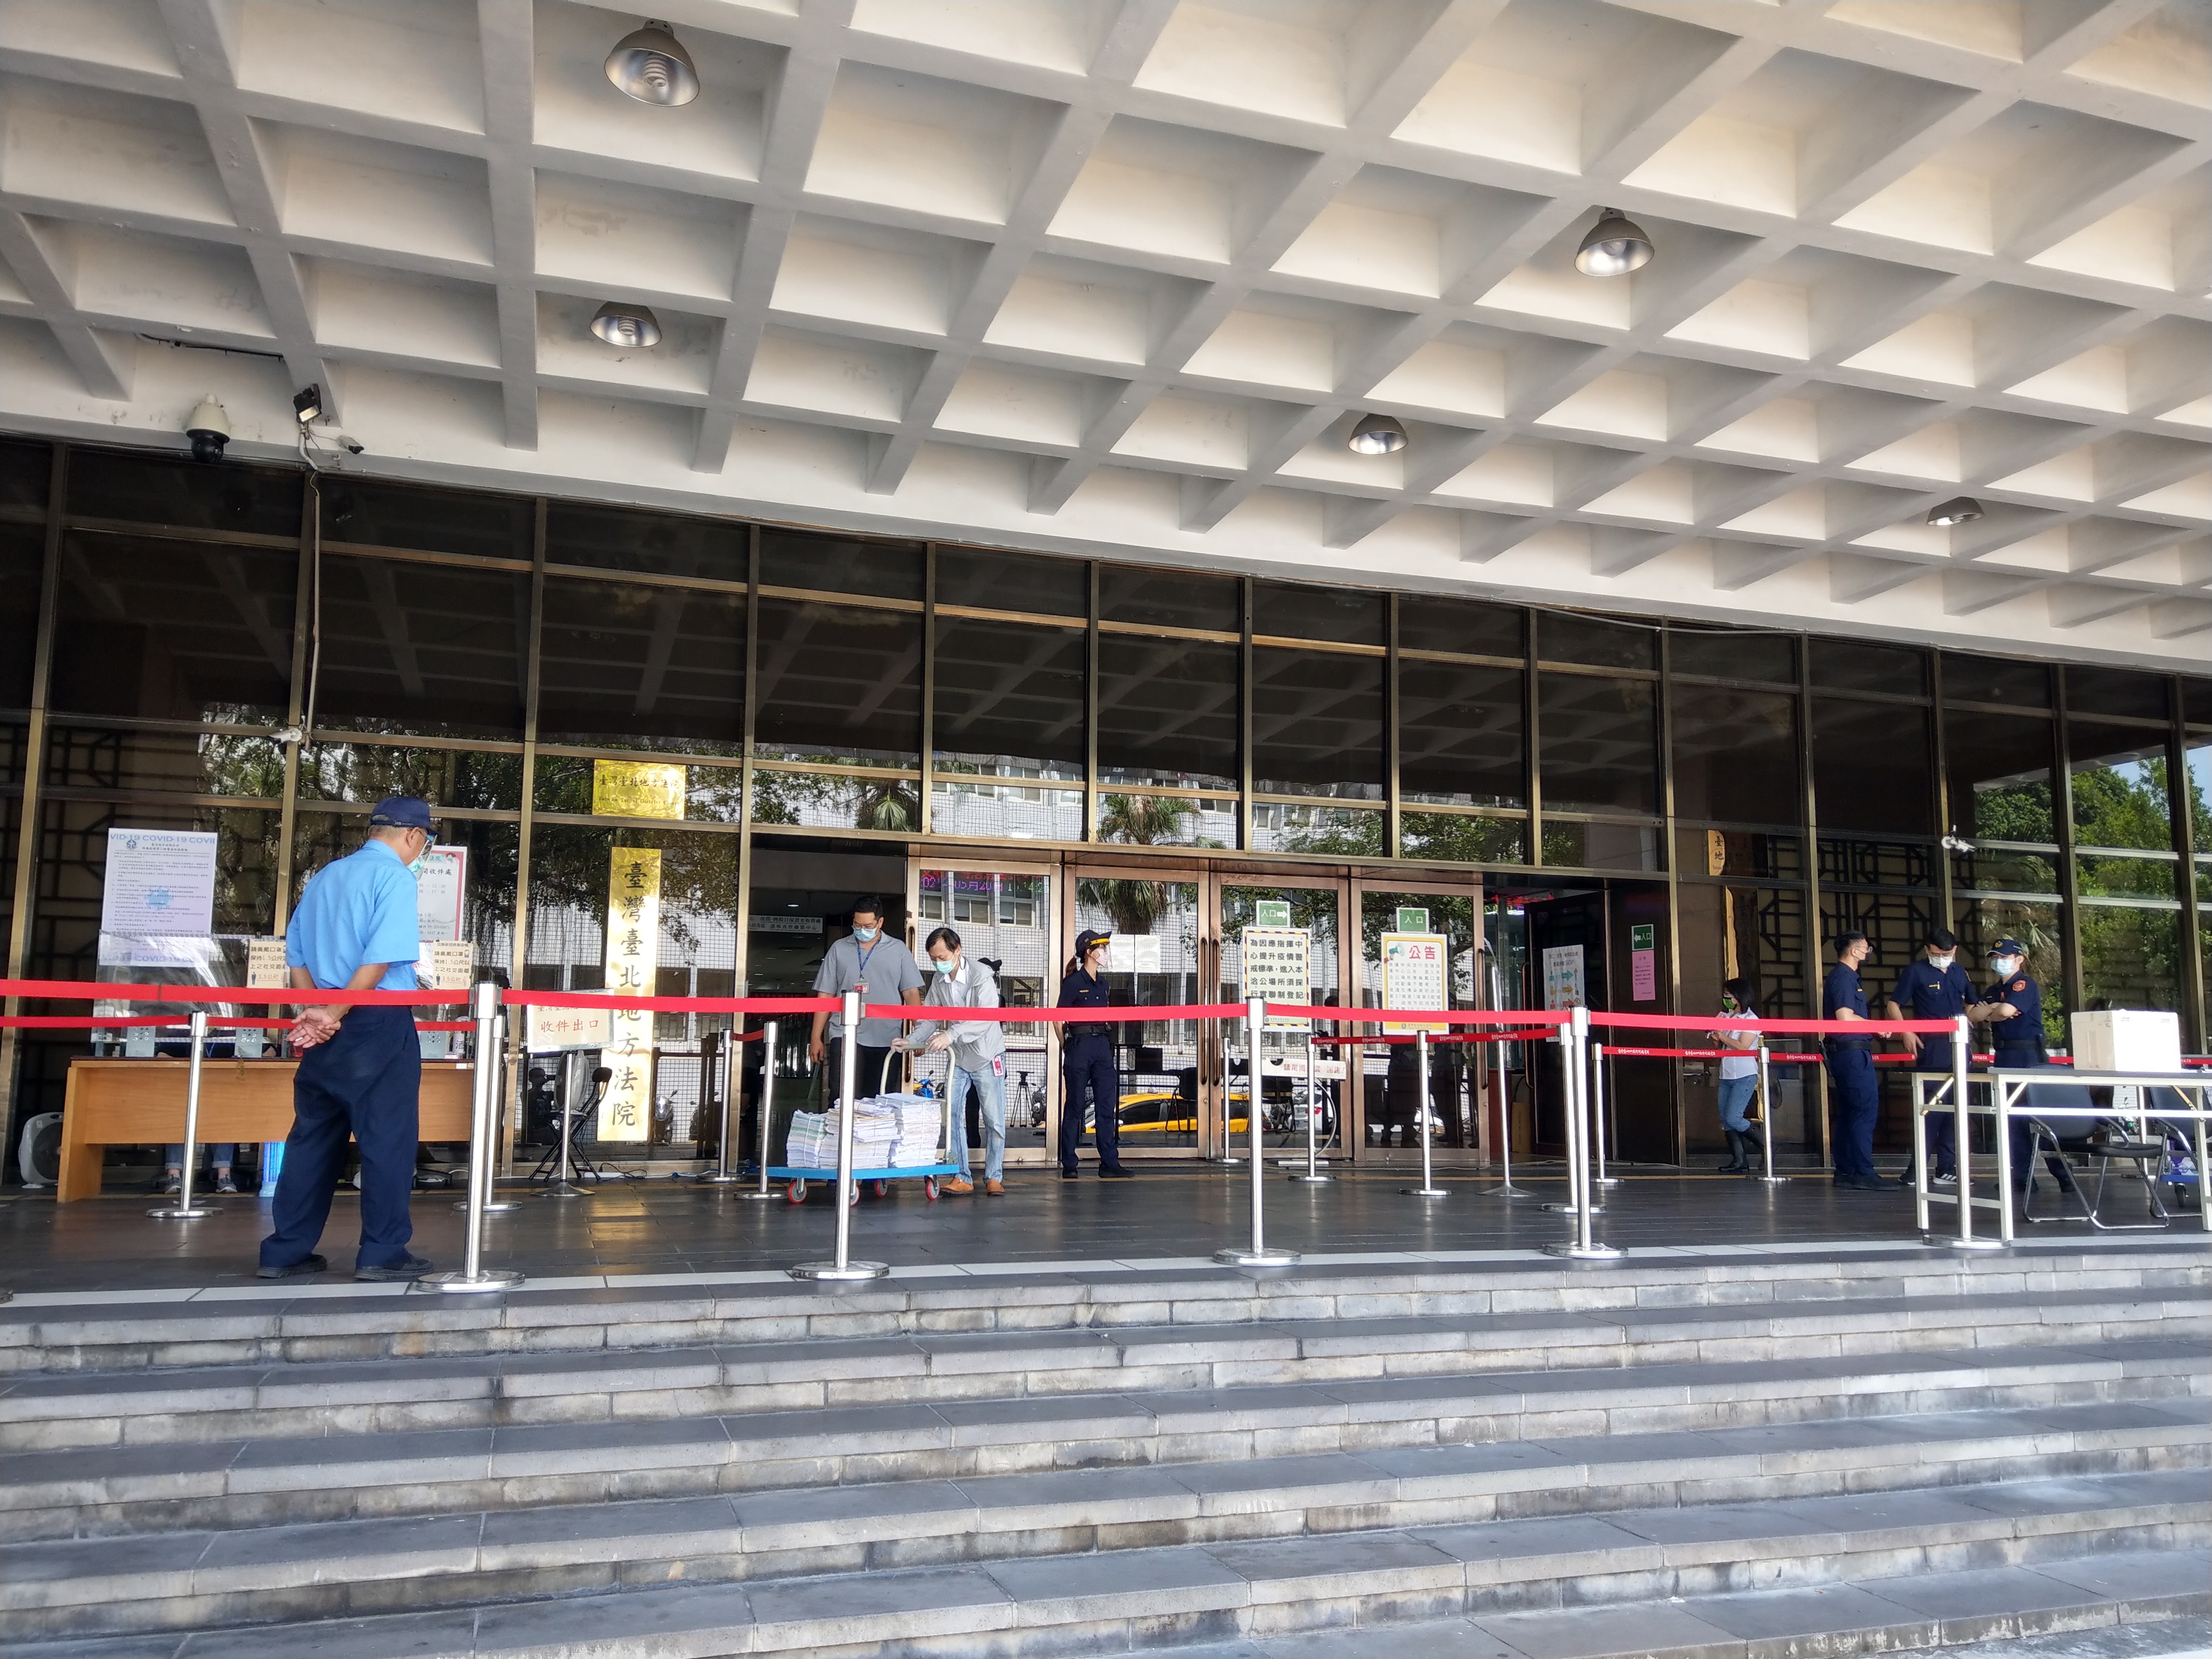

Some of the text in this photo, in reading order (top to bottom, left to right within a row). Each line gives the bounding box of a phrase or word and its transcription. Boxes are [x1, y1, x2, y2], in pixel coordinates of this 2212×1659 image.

[599, 774, 680, 789] 臺灣臺北地方法院
[1261, 910, 1276, 918] 入口
[1404, 915, 1424, 924] 入口
[1641, 933, 1651, 941] 入口
[1250, 939, 1303, 949] 為因應指揮中
[1250, 952, 1303, 961] 心提升疫情警
[1409, 945, 1436, 960] 公告
[1250, 977, 1304, 986] 洽公場所須採
[611, 861, 648, 1127] 臺灣臺北地方法院
[1250, 990, 1304, 1000] 行實聯制登記
[541, 1019, 599, 1033] 收件出口
[455, 1040, 464, 1049] 酒
